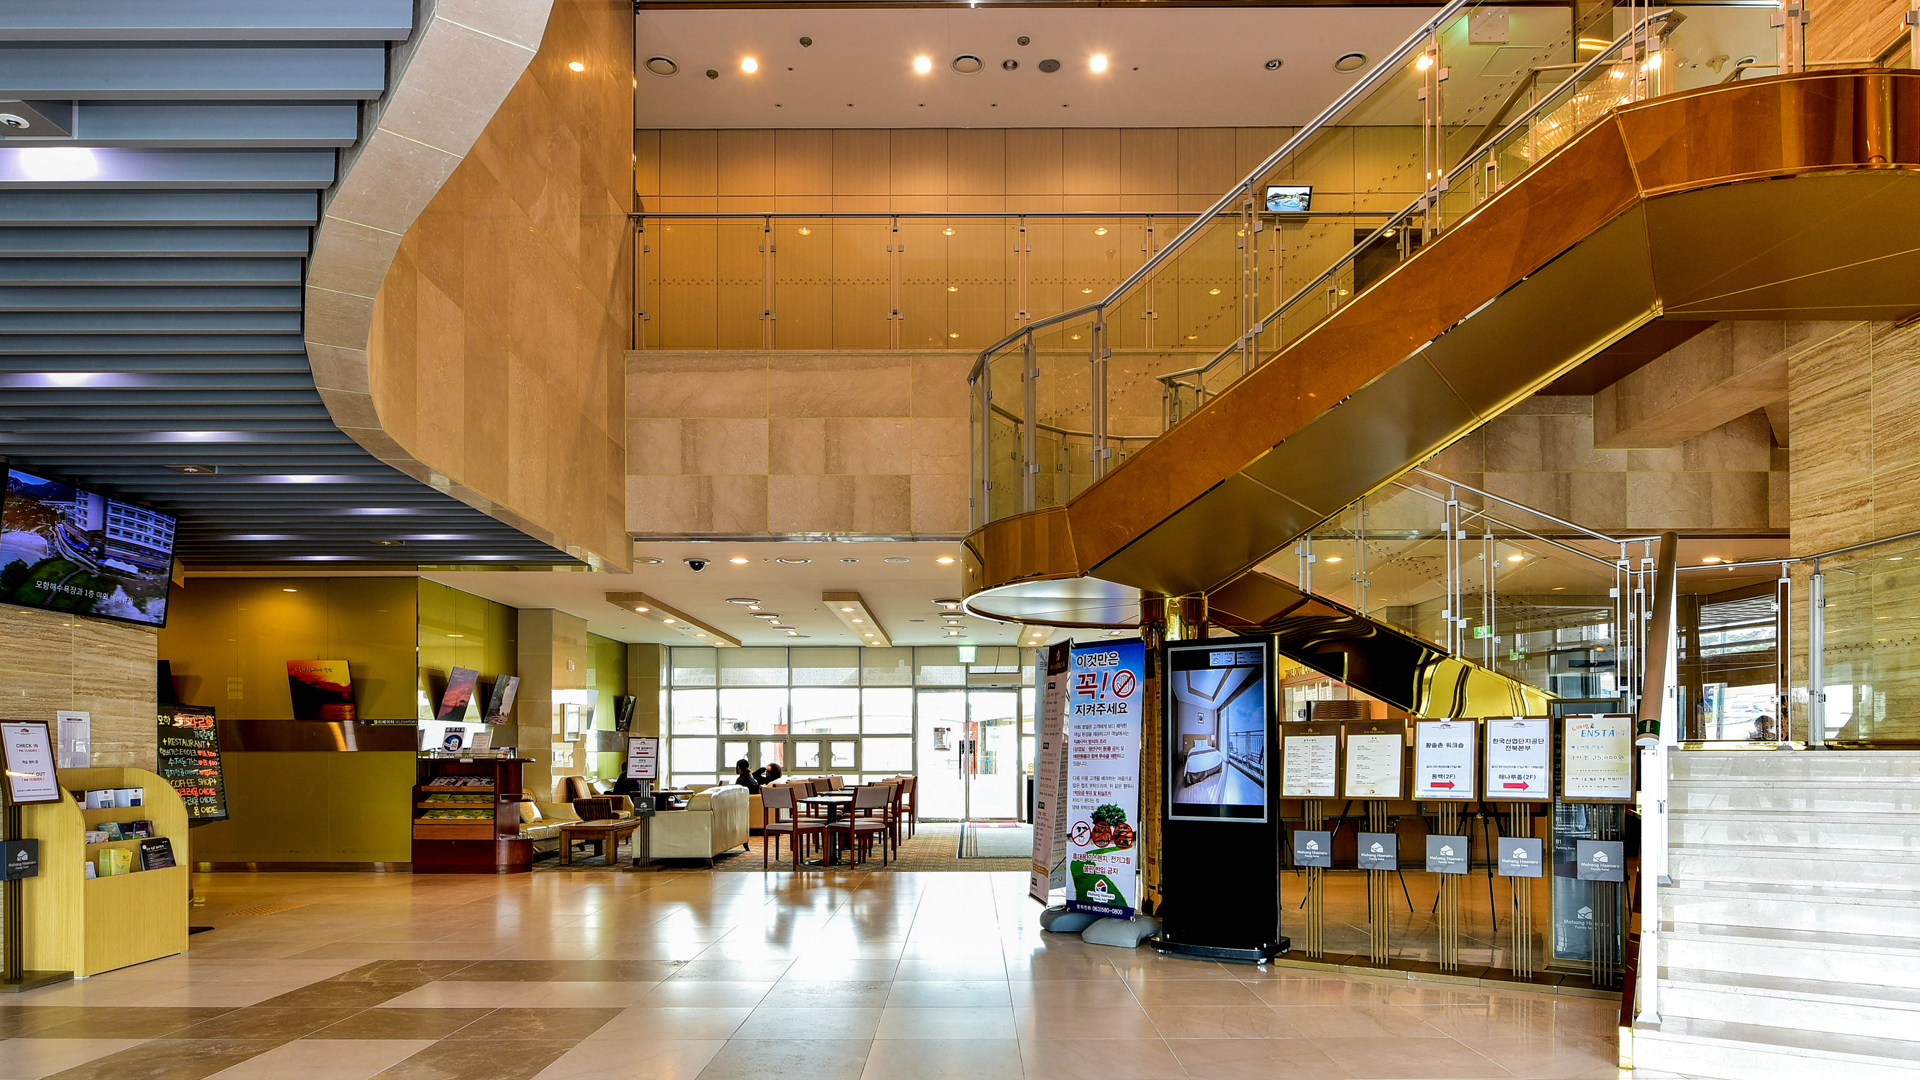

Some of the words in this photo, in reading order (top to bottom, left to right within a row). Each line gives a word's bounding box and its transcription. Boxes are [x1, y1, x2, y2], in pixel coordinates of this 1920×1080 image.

[35, 580, 82, 596] 모항해수욕장과
[84, 589, 94, 598] 1층
[1076, 651, 1119, 668] 이것만은
[1075, 672, 1109, 700] 꼭!
[1075, 702, 1128, 716] 지켜주세요
[168, 738, 206, 748] RESTAURANT
[198, 778, 214, 786] SHOP
[1108, 867, 1118, 876] 금지
[1564, 919, 1586, 927] Mohang
